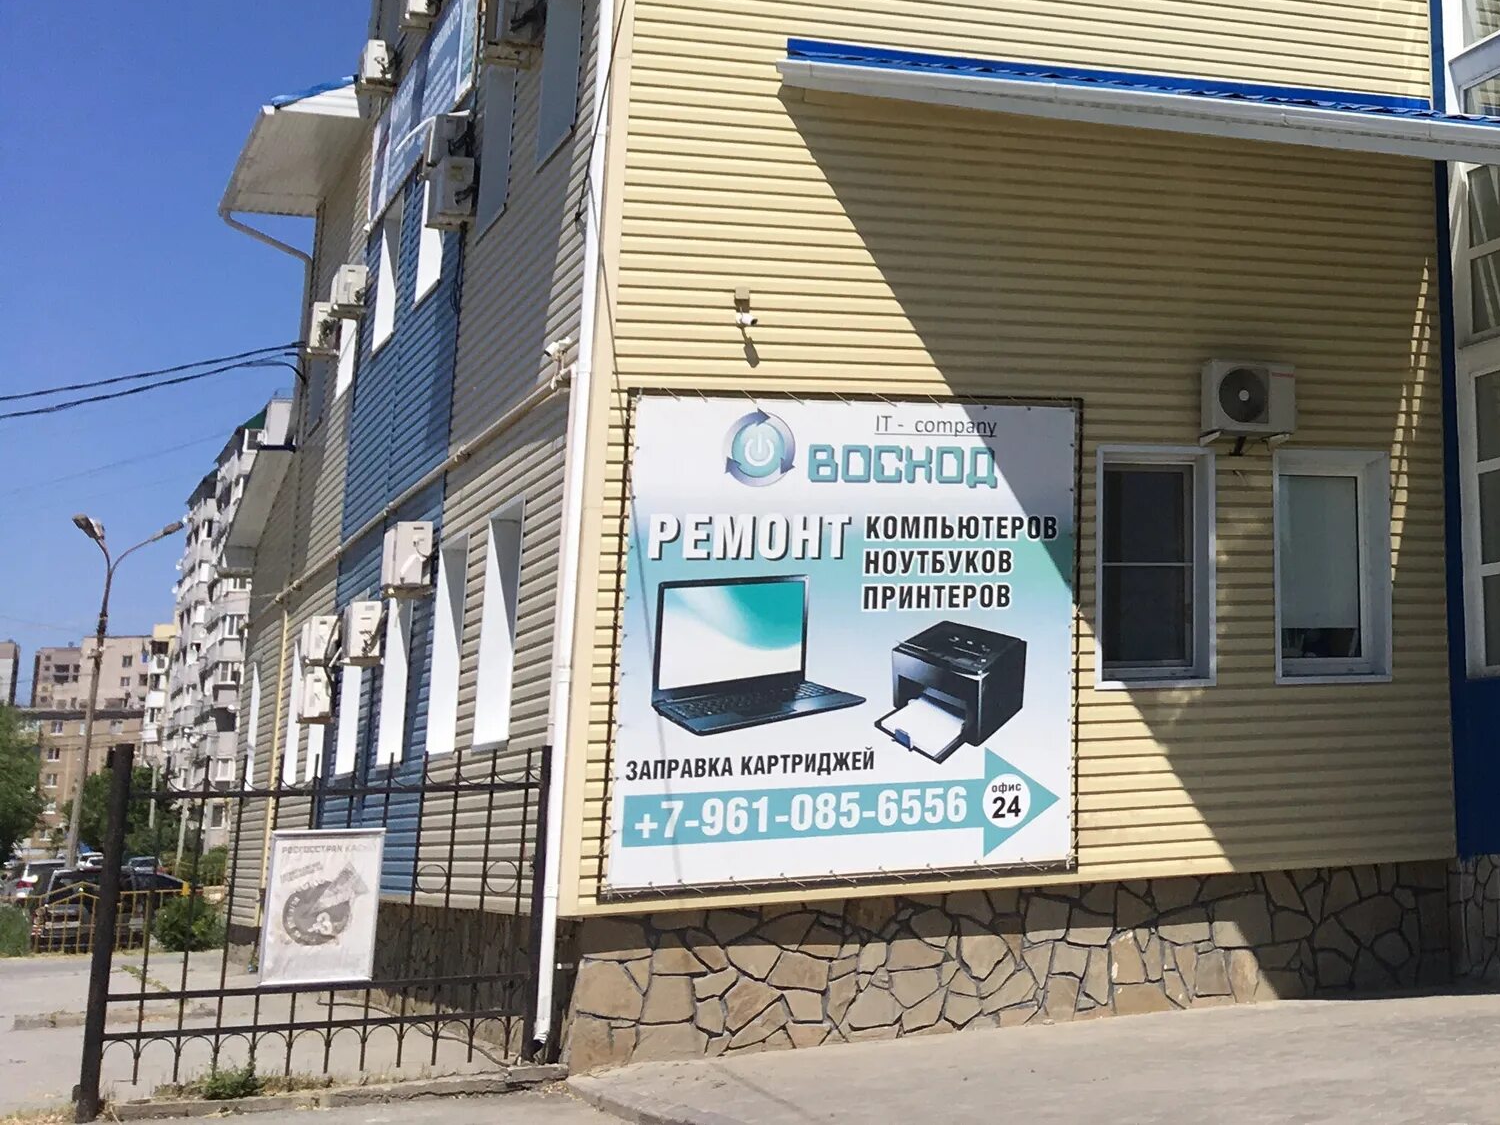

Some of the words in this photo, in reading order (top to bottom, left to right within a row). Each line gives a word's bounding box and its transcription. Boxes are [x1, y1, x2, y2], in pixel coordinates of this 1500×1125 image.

[875, 415, 893, 432] IT
[914, 420, 997, 437] company
[808, 444, 998, 488] ВОСХОД
[648, 512, 852, 561] РЕМОНТ
[866, 516, 1057, 540] КОМПЬЮТЕРОВ
[865, 550, 1012, 574] НОУТБУКОВ
[863, 584, 1010, 609] ПРИНТЕРОВ
[625, 756, 733, 781] ЗАПРАВКА
[740, 746, 875, 776] КАРТРИДЖЕЙ
[991, 782, 1022, 794] офис
[634, 785, 968, 839] +7-961-085-6556
[991, 795, 1021, 819] 24
